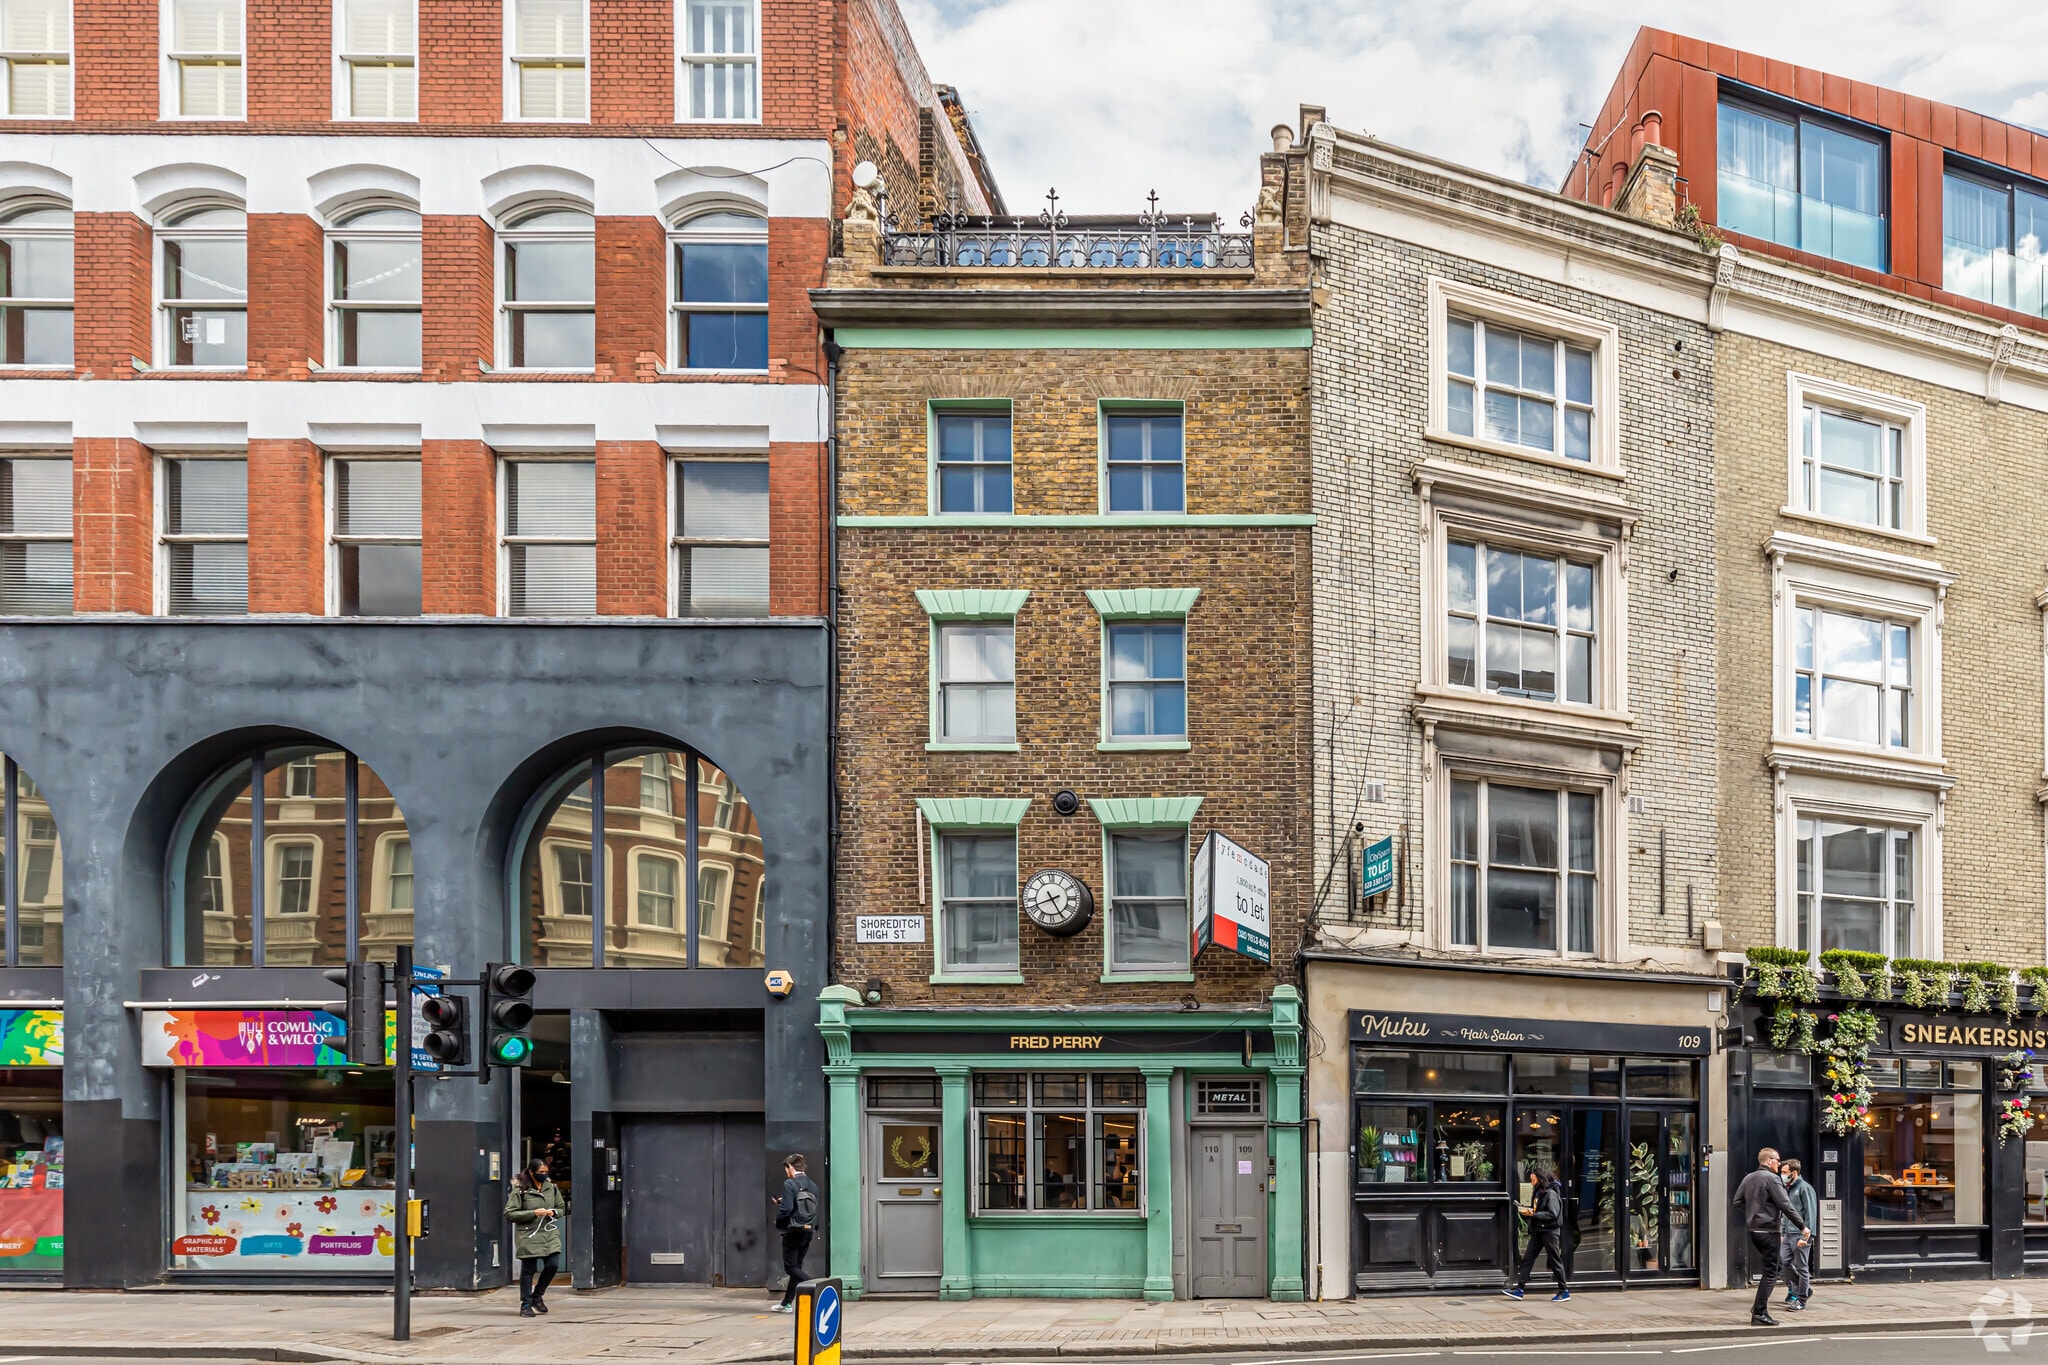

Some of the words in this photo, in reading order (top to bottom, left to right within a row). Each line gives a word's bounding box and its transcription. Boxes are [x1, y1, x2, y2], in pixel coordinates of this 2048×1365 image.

[1367, 865, 1378, 878] TO
[1378, 858, 1390, 874] LET
[1236, 891, 1248, 914] to
[1250, 897, 1265, 922] let
[860, 919, 921, 929] SHOREDITCH
[866, 929, 888, 939] HIGH
[412, 969, 438, 980] OWLING
[267, 1021, 332, 1033] COWLING
[1361, 1014, 1430, 1038] Muku
[1460, 1028, 1490, 1040] Hair
[1490, 1028, 1525, 1042] Salon
[1678, 1035, 1701, 1048] 109
[268, 1034, 278, 1045] &
[1904, 1023, 2048, 1048] SNEAKERSNS
[1010, 1036, 1050, 1049] FRED
[1053, 1036, 1103, 1049] PERRY
[1212, 1093, 1247, 1102] METAL
[1204, 1145, 1219, 1153] 110
[1238, 1145, 1253, 1153] 109
[1208, 1155, 1214, 1163] A
[1825, 1203, 1836, 1211] 108
[186, 1246, 224, 1254] MATERIALS
[320, 1241, 362, 1250] PORTFOLIOS
